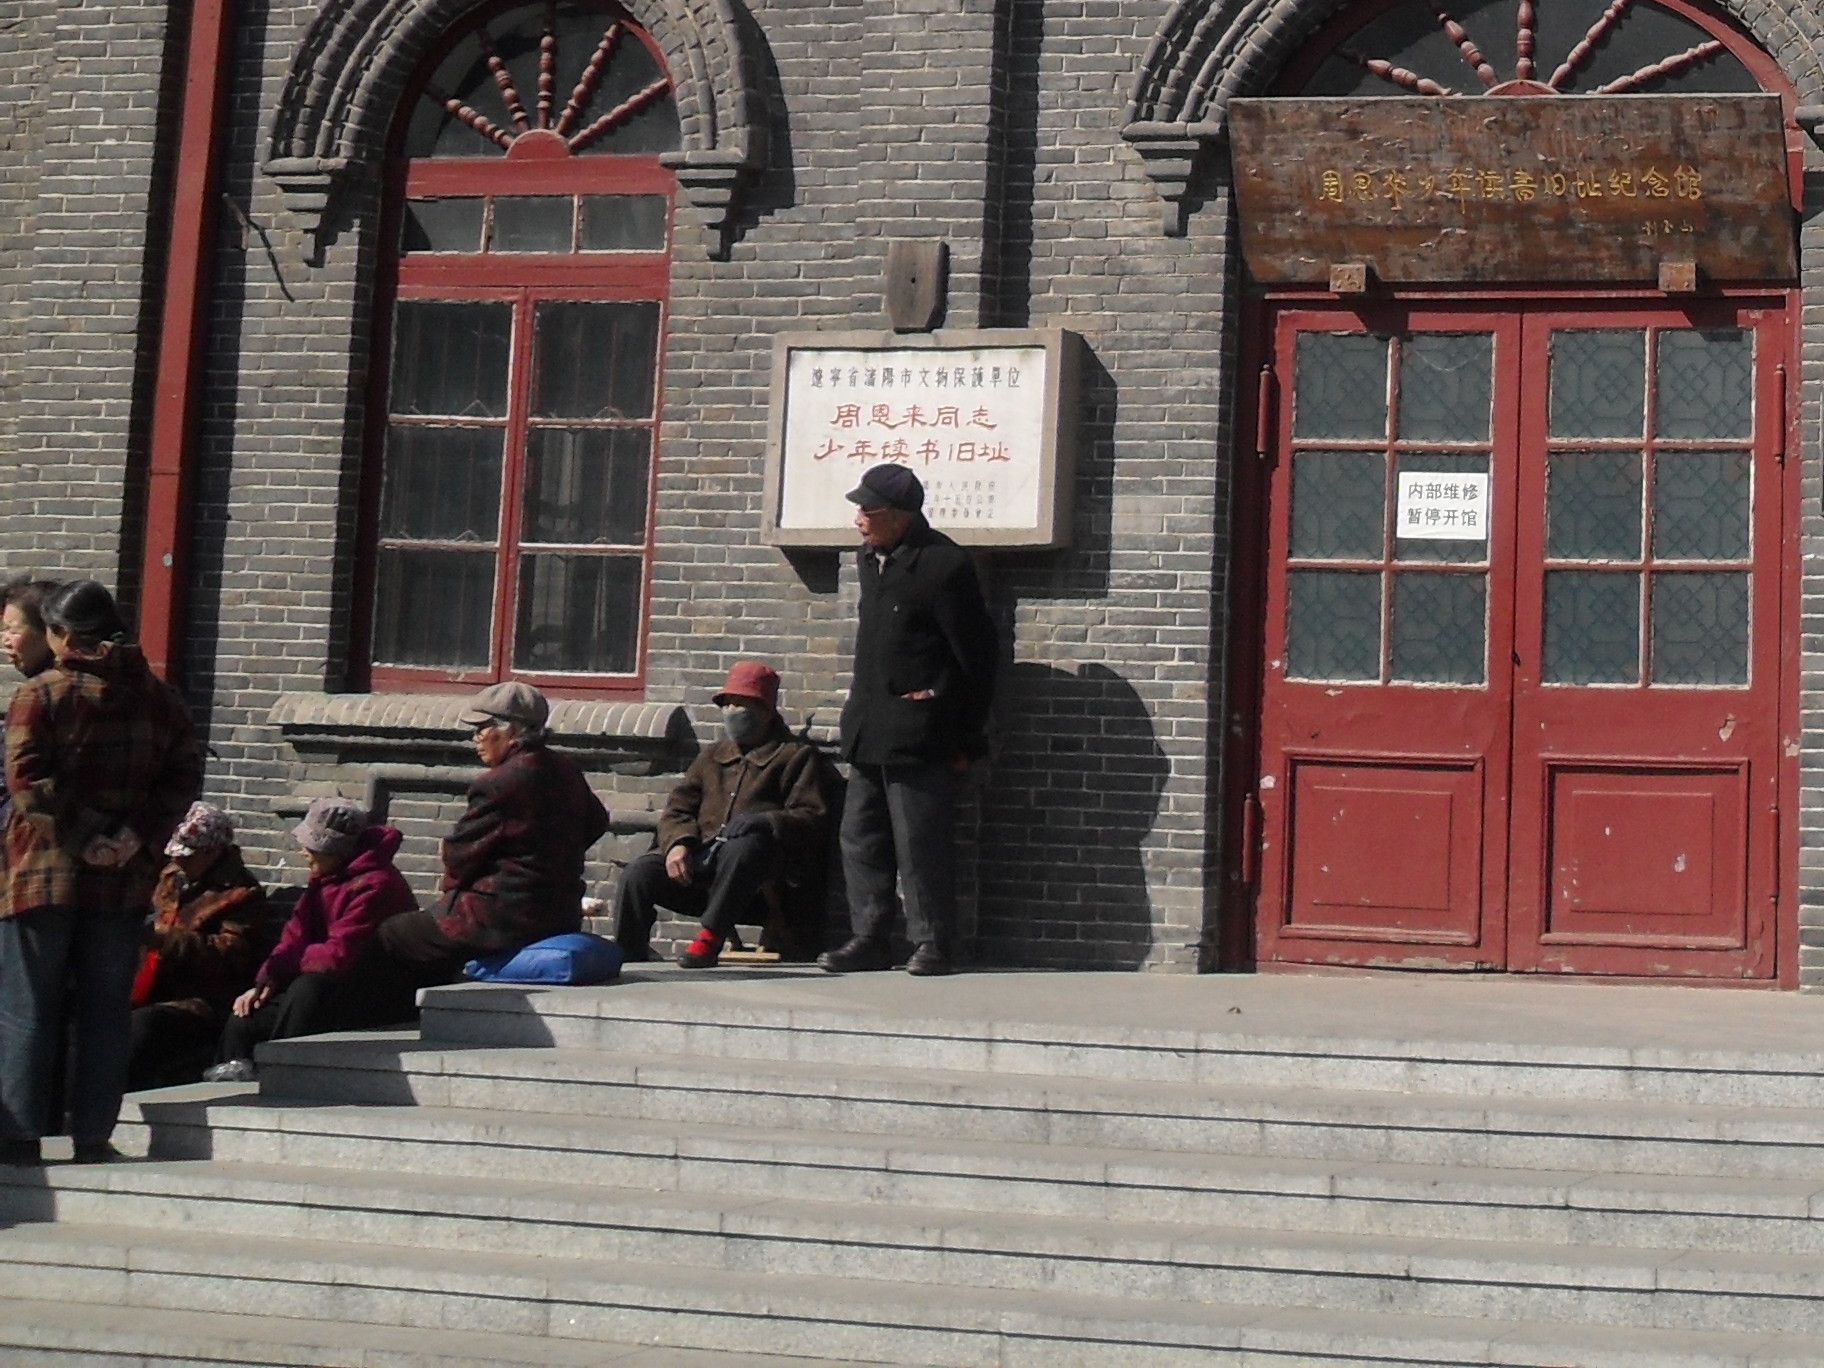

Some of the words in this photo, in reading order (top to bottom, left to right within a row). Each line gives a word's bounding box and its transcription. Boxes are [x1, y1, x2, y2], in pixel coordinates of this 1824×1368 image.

[830, 404, 998, 430] 周恩来同志
[812, 438, 1011, 465] 少年读书旧址
[1408, 482, 1479, 500] 内部维修
[1408, 507, 1478, 527] 暂停开馆
